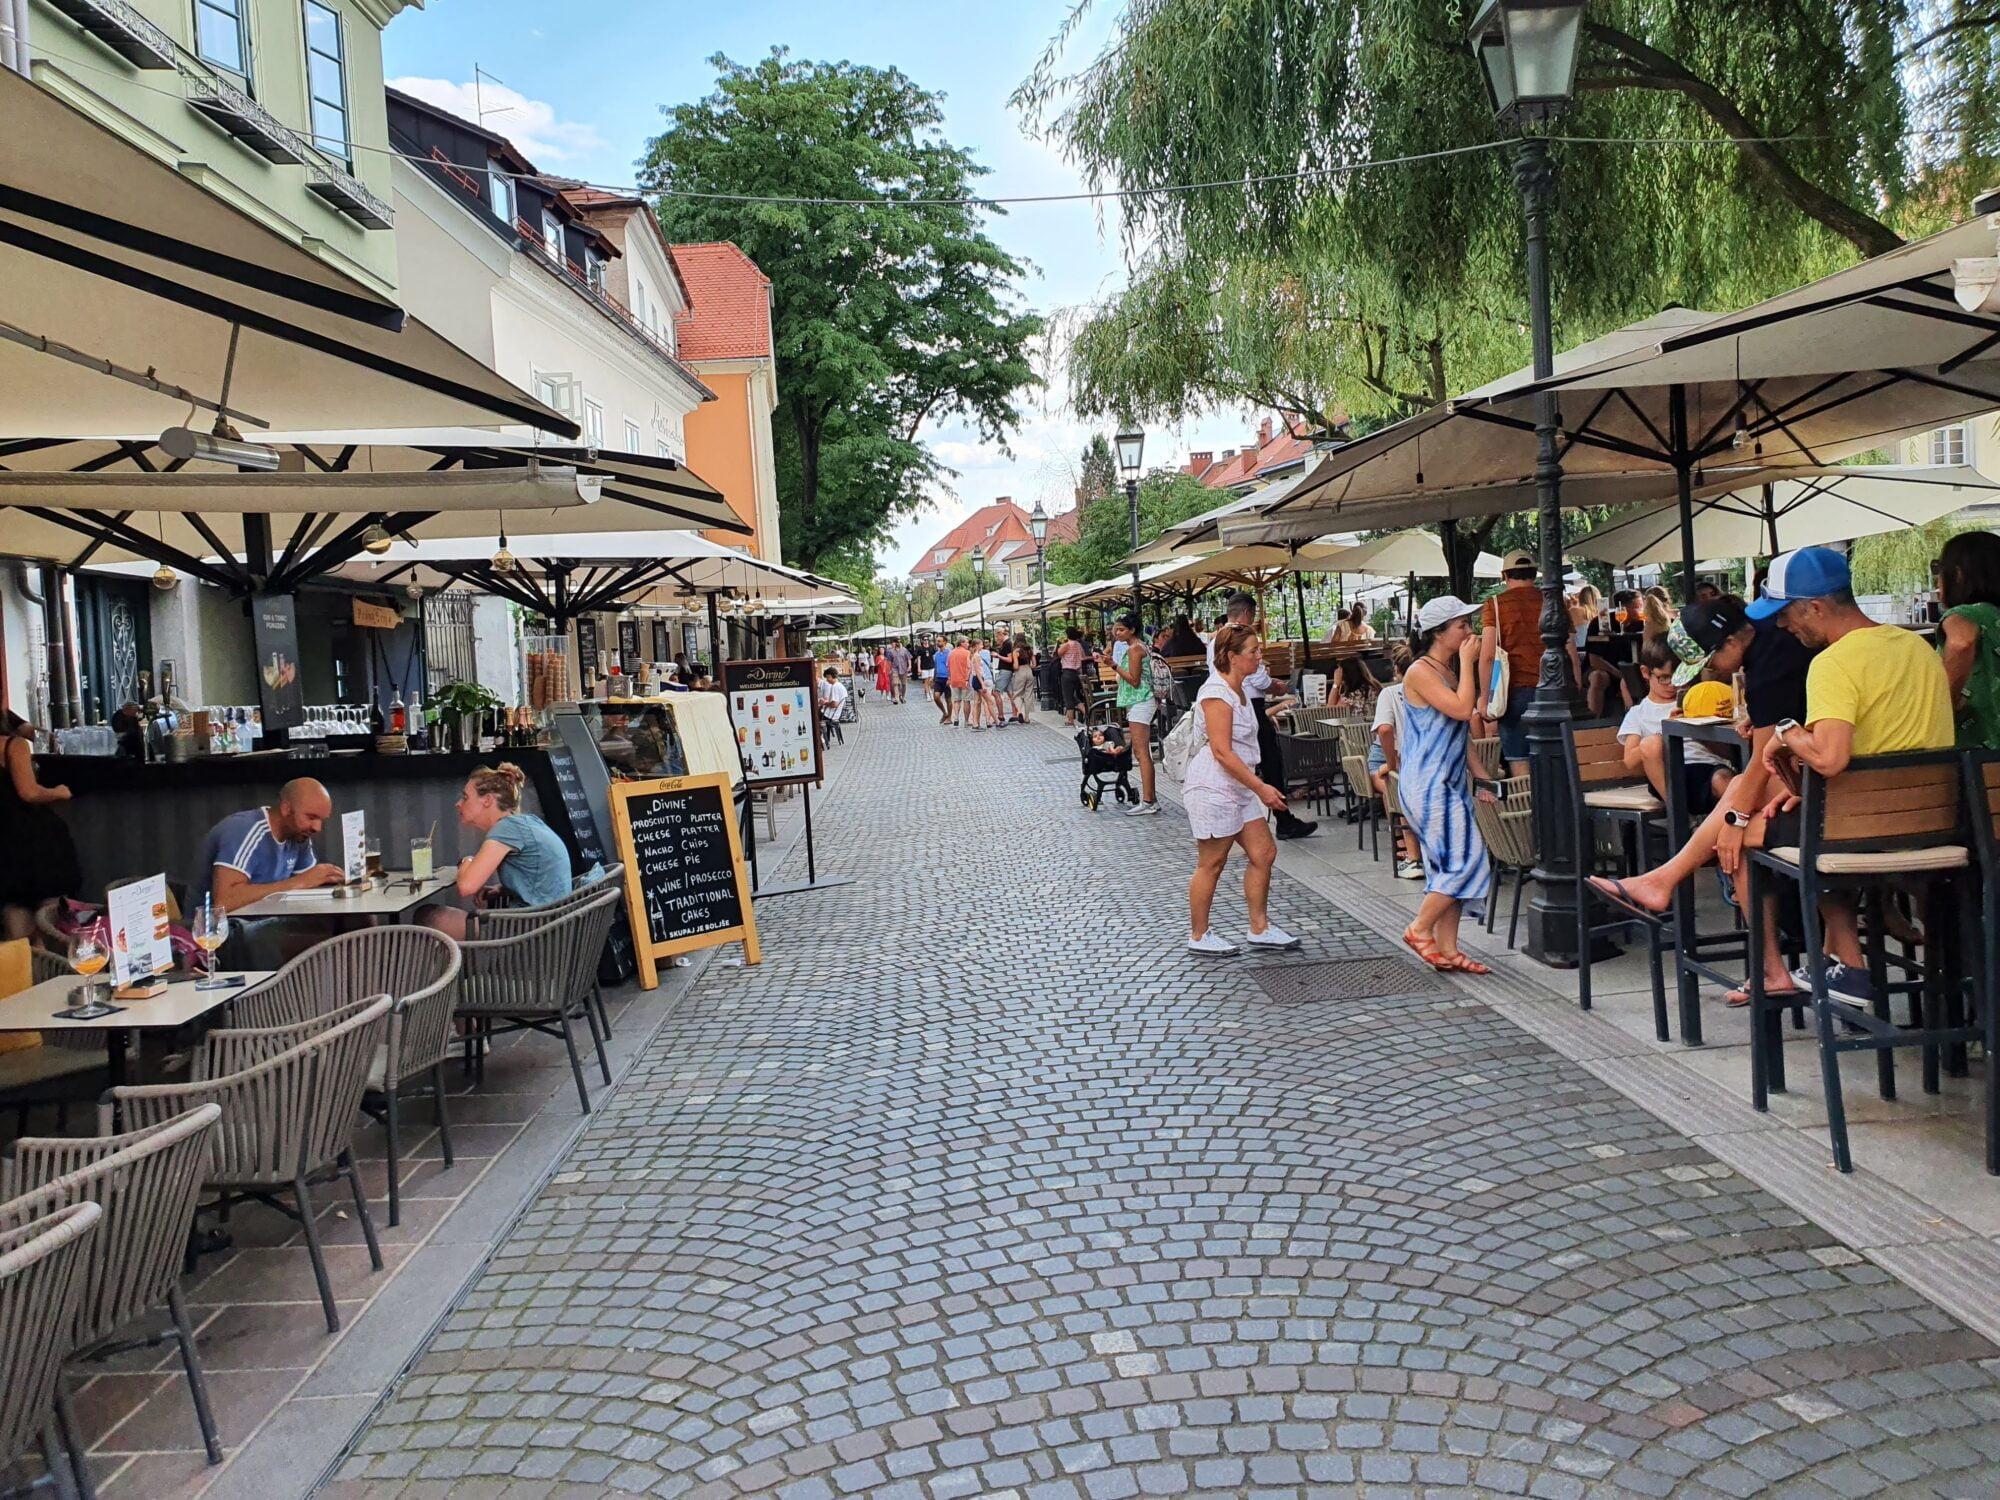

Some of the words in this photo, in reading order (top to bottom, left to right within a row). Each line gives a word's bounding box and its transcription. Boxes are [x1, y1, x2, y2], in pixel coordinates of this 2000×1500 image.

[633, 814, 682, 830] PROSCIUTTO
[690, 812, 723, 822] PLATTER
[637, 829, 671, 843] CHEESE
[681, 824, 720, 837] PLATTER
[646, 858, 679, 875] CHEESE
[681, 907, 711, 924] CAKES
[669, 926, 696, 939] SKUPAJ
[696, 924, 704, 933] JE
[704, 919, 730, 933] BOLJŠE
